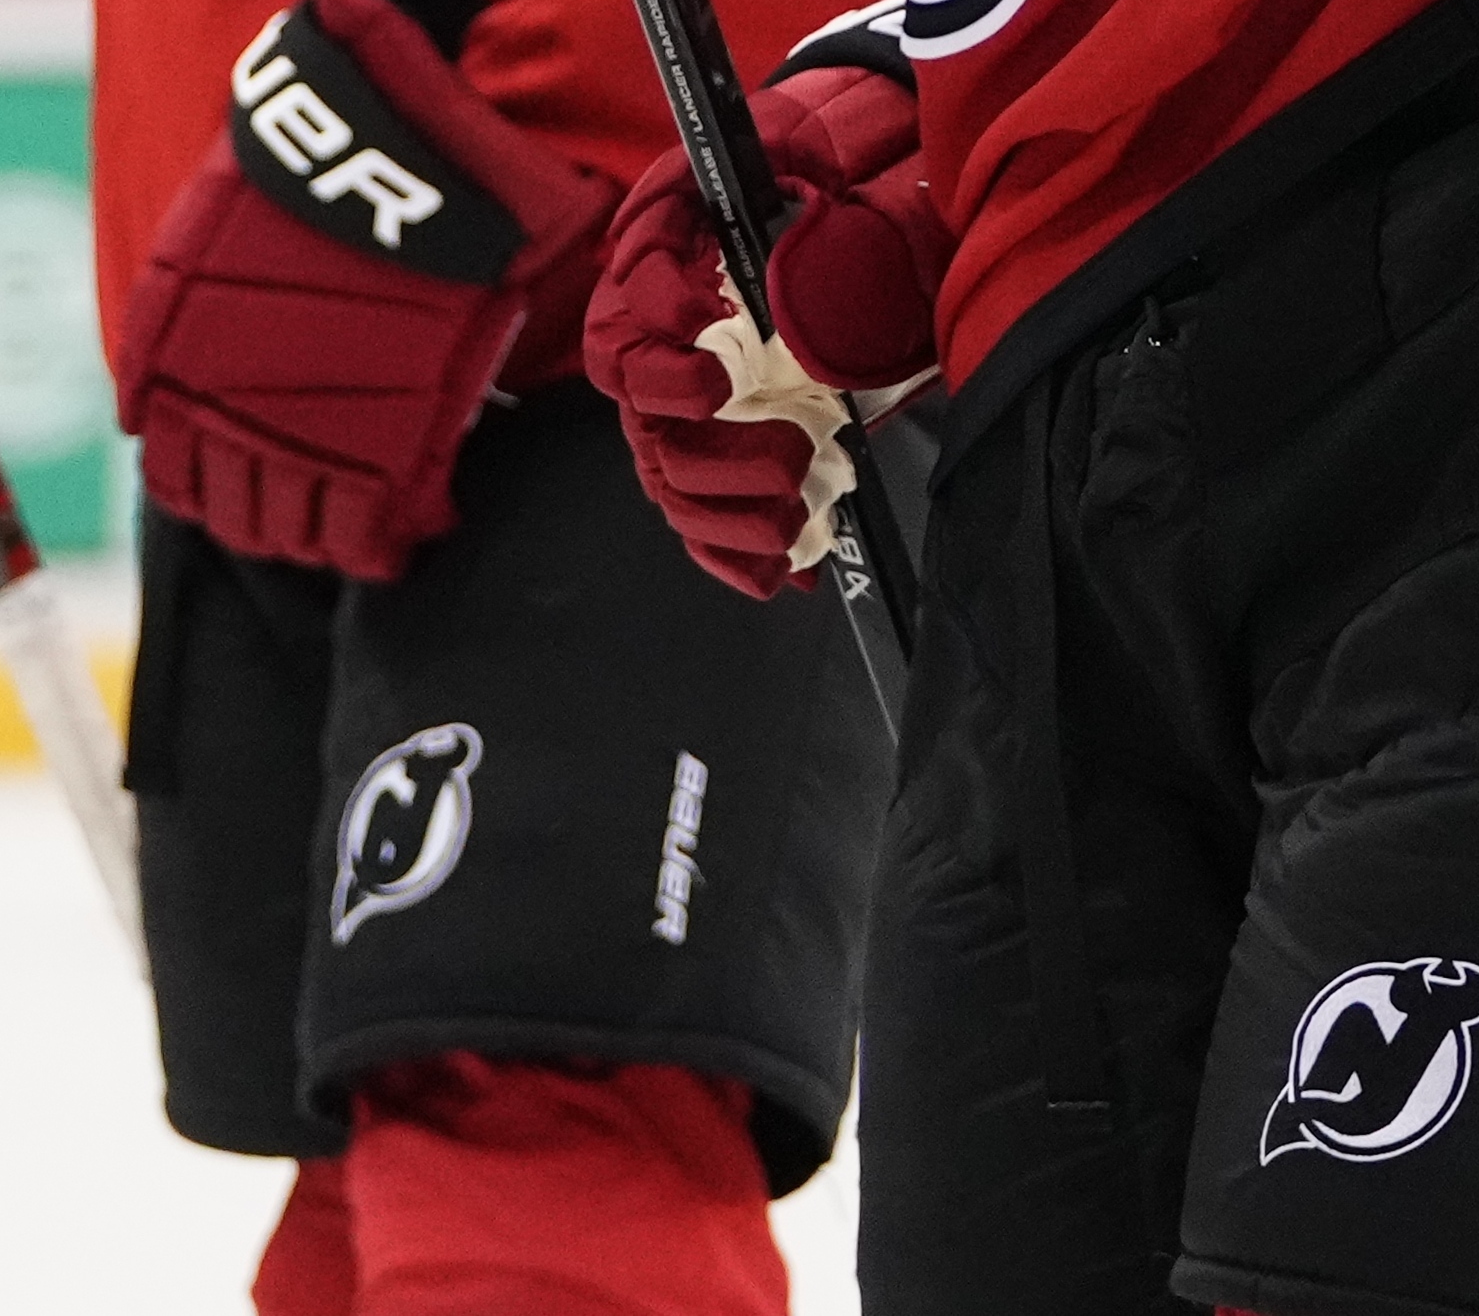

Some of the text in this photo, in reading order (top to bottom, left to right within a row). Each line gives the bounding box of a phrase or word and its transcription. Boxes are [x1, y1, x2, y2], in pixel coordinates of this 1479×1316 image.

[230, 9, 443, 250] UER
[668, 61, 706, 134] LANCER
[698, 143, 737, 223] RELEASE
